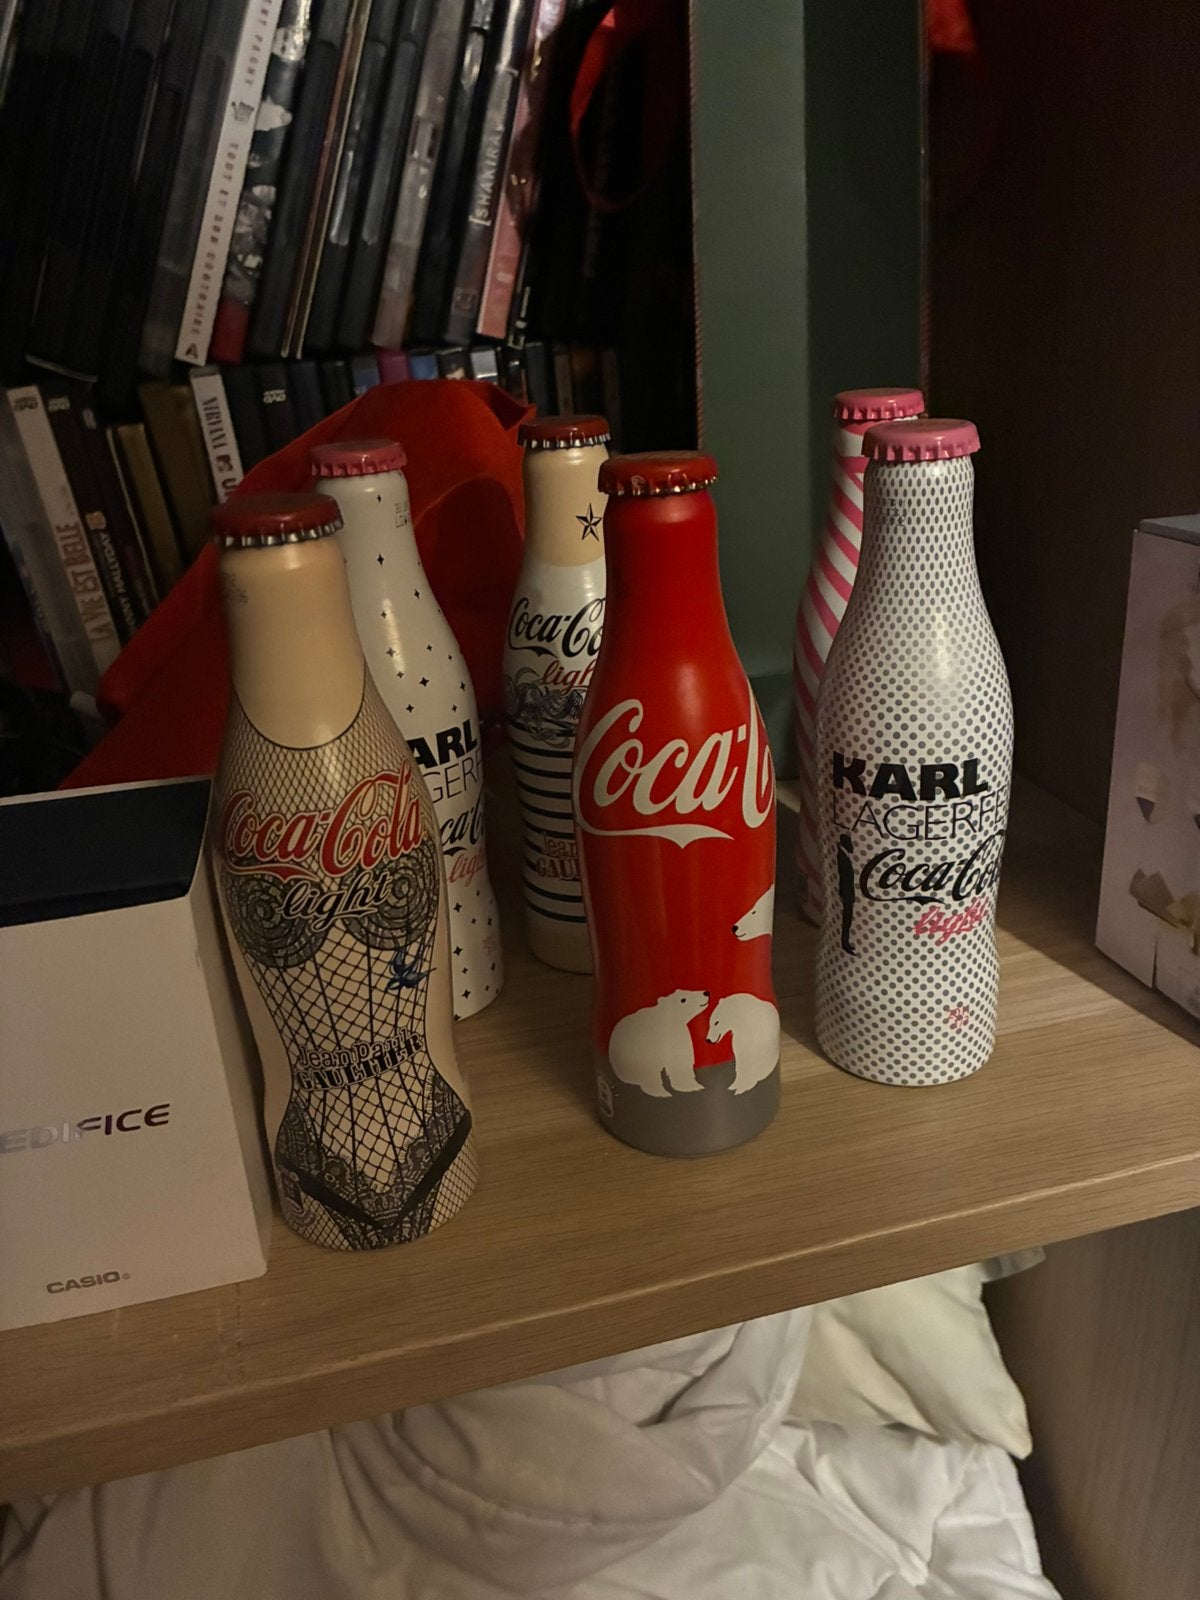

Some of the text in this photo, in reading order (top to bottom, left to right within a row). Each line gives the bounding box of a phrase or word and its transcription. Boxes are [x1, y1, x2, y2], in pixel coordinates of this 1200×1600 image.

[508, 597, 606, 659] Coca-Co
[538, 659, 597, 698] ligh
[406, 719, 478, 769] ARL
[571, 683, 777, 849] Coca-C
[832, 751, 989, 801] KARL
[222, 756, 424, 883] Coca-Cola
[277, 870, 394, 933] light
[0, 1103, 170, 1154] EDIFICE
[46, 1270, 121, 1294] CASIO
